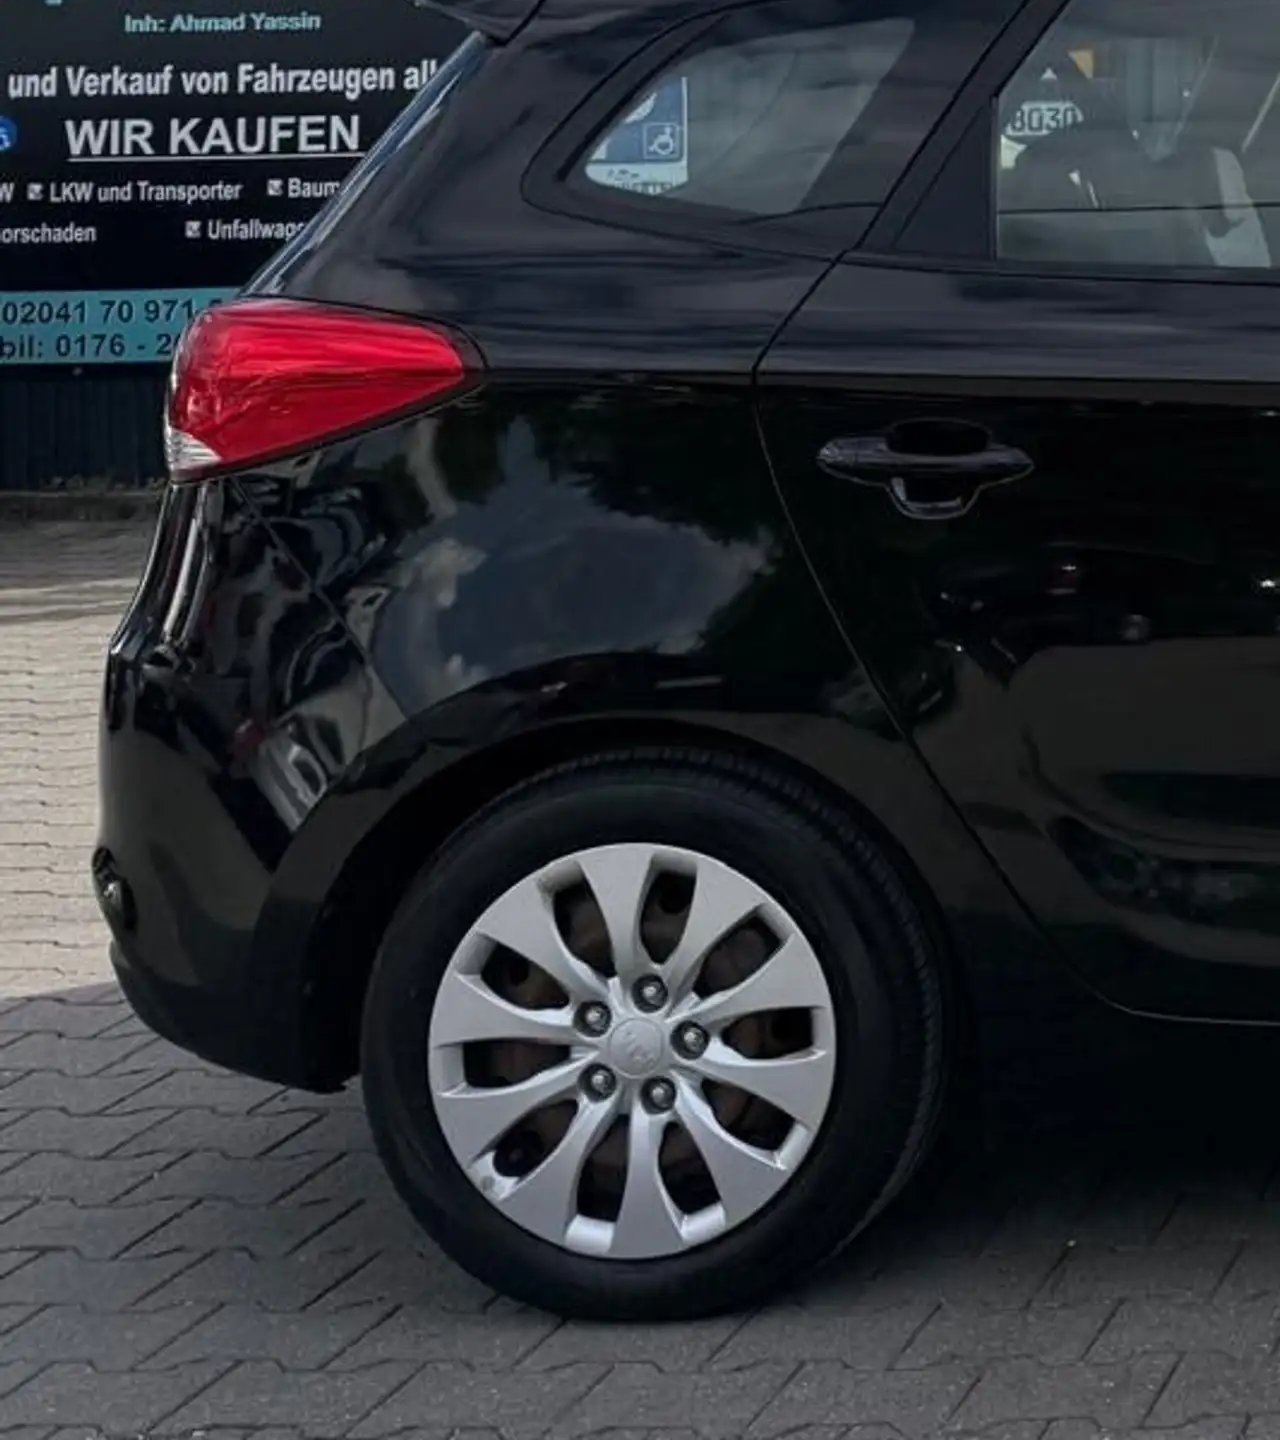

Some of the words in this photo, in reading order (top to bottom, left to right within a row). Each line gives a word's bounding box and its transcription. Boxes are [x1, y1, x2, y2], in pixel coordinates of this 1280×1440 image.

[125, 14, 165, 33] Inh:
[170, 13, 245, 32] Ahmad
[251, 12, 321, 31] Yassin
[8, 66, 57, 99] und
[66, 64, 173, 97] Verkauf
[182, 73, 229, 95] von
[238, 61, 394, 101] Fahrzeugen
[65, 119, 155, 156] WIR
[170, 115, 360, 155] KAUFEN
[50, 182, 94, 203] LKW
[98, 183, 131, 203] und
[137, 181, 243, 205] Transporter
[3, 300, 87, 326] 02041
[100, 299, 133, 324] 70
[56, 334, 125, 358] 0176
[156, 333, 181, 357] 2
